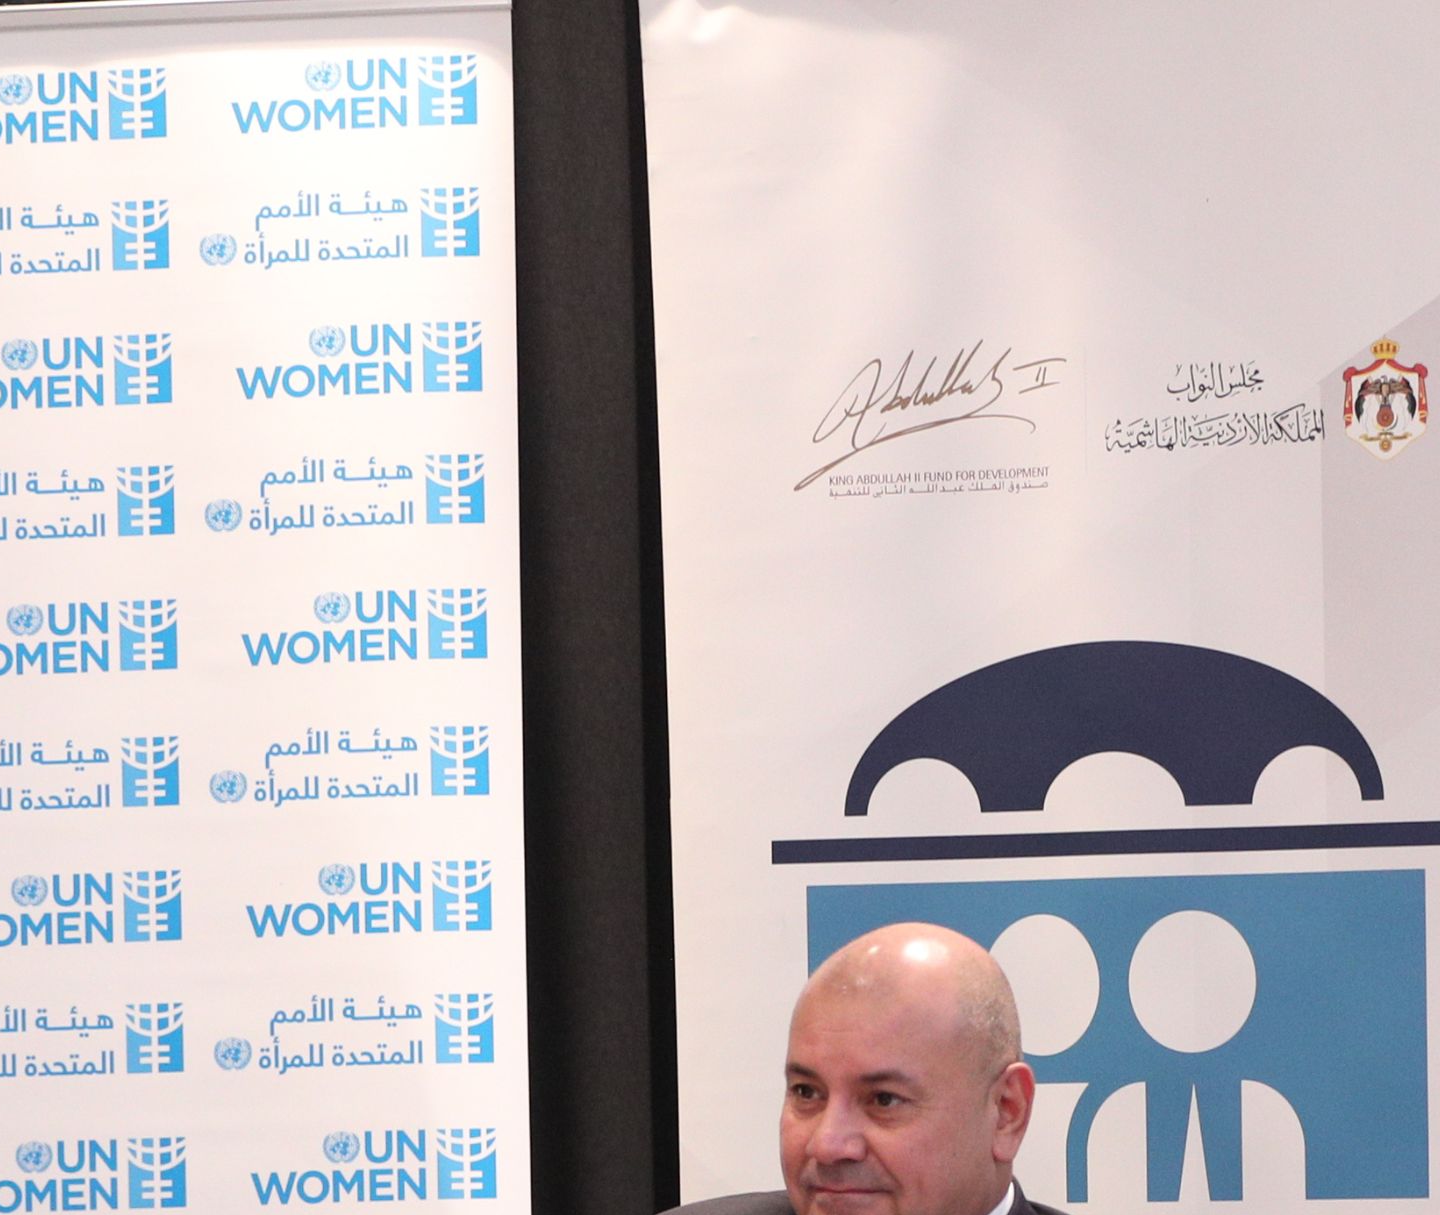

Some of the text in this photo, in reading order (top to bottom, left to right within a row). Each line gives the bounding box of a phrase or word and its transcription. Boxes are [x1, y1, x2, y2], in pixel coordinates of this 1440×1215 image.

[36, 70, 99, 107] UN
[345, 56, 408, 92] UN
[230, 94, 409, 135] WOMEN
[19, 206, 101, 235] هيئة
[255, 191, 409, 232] هيئة الأمم
[9, 248, 102, 276] المتحدة
[247, 230, 409, 268] المتحدة للمرأة
[41, 335, 105, 372] UN
[350, 321, 413, 358] UN
[235, 359, 414, 401] WOMEN
[25, 470, 107, 500] هيئة
[259, 458, 414, 498] هيئة الأمم
[828, 475, 855, 486] KING
[856, 472, 912, 485] ABDULLAH
[923, 470, 953, 483] FUND
[955, 470, 976, 481] FOR
[978, 466, 1050, 480] DEVELOPMENT
[14, 512, 107, 541] المتحدة
[252, 498, 415, 536] المتحدة للمرأة
[47, 600, 111, 637] UN
[354, 588, 418, 625] UN
[241, 626, 419, 667] WOMEN
[30, 740, 111, 772] هيئة
[264, 729, 418, 769] هيئة الأمم
[19, 783, 112, 811] المتحدة
[254, 768, 420, 807] المتحدة للمرأة
[51, 871, 114, 908] UN
[359, 860, 423, 897] UN
[245, 898, 424, 939] WOMEN
[34, 1007, 115, 1038] هيئة
[268, 996, 424, 1037] هيئة الأمم
[24, 1050, 116, 1078] المتحدة
[258, 1038, 425, 1074] المتحدة للمرأة
[56, 1138, 119, 1174] UN
[363, 1128, 428, 1165] UN
[250, 1166, 429, 1206] WOMEN
